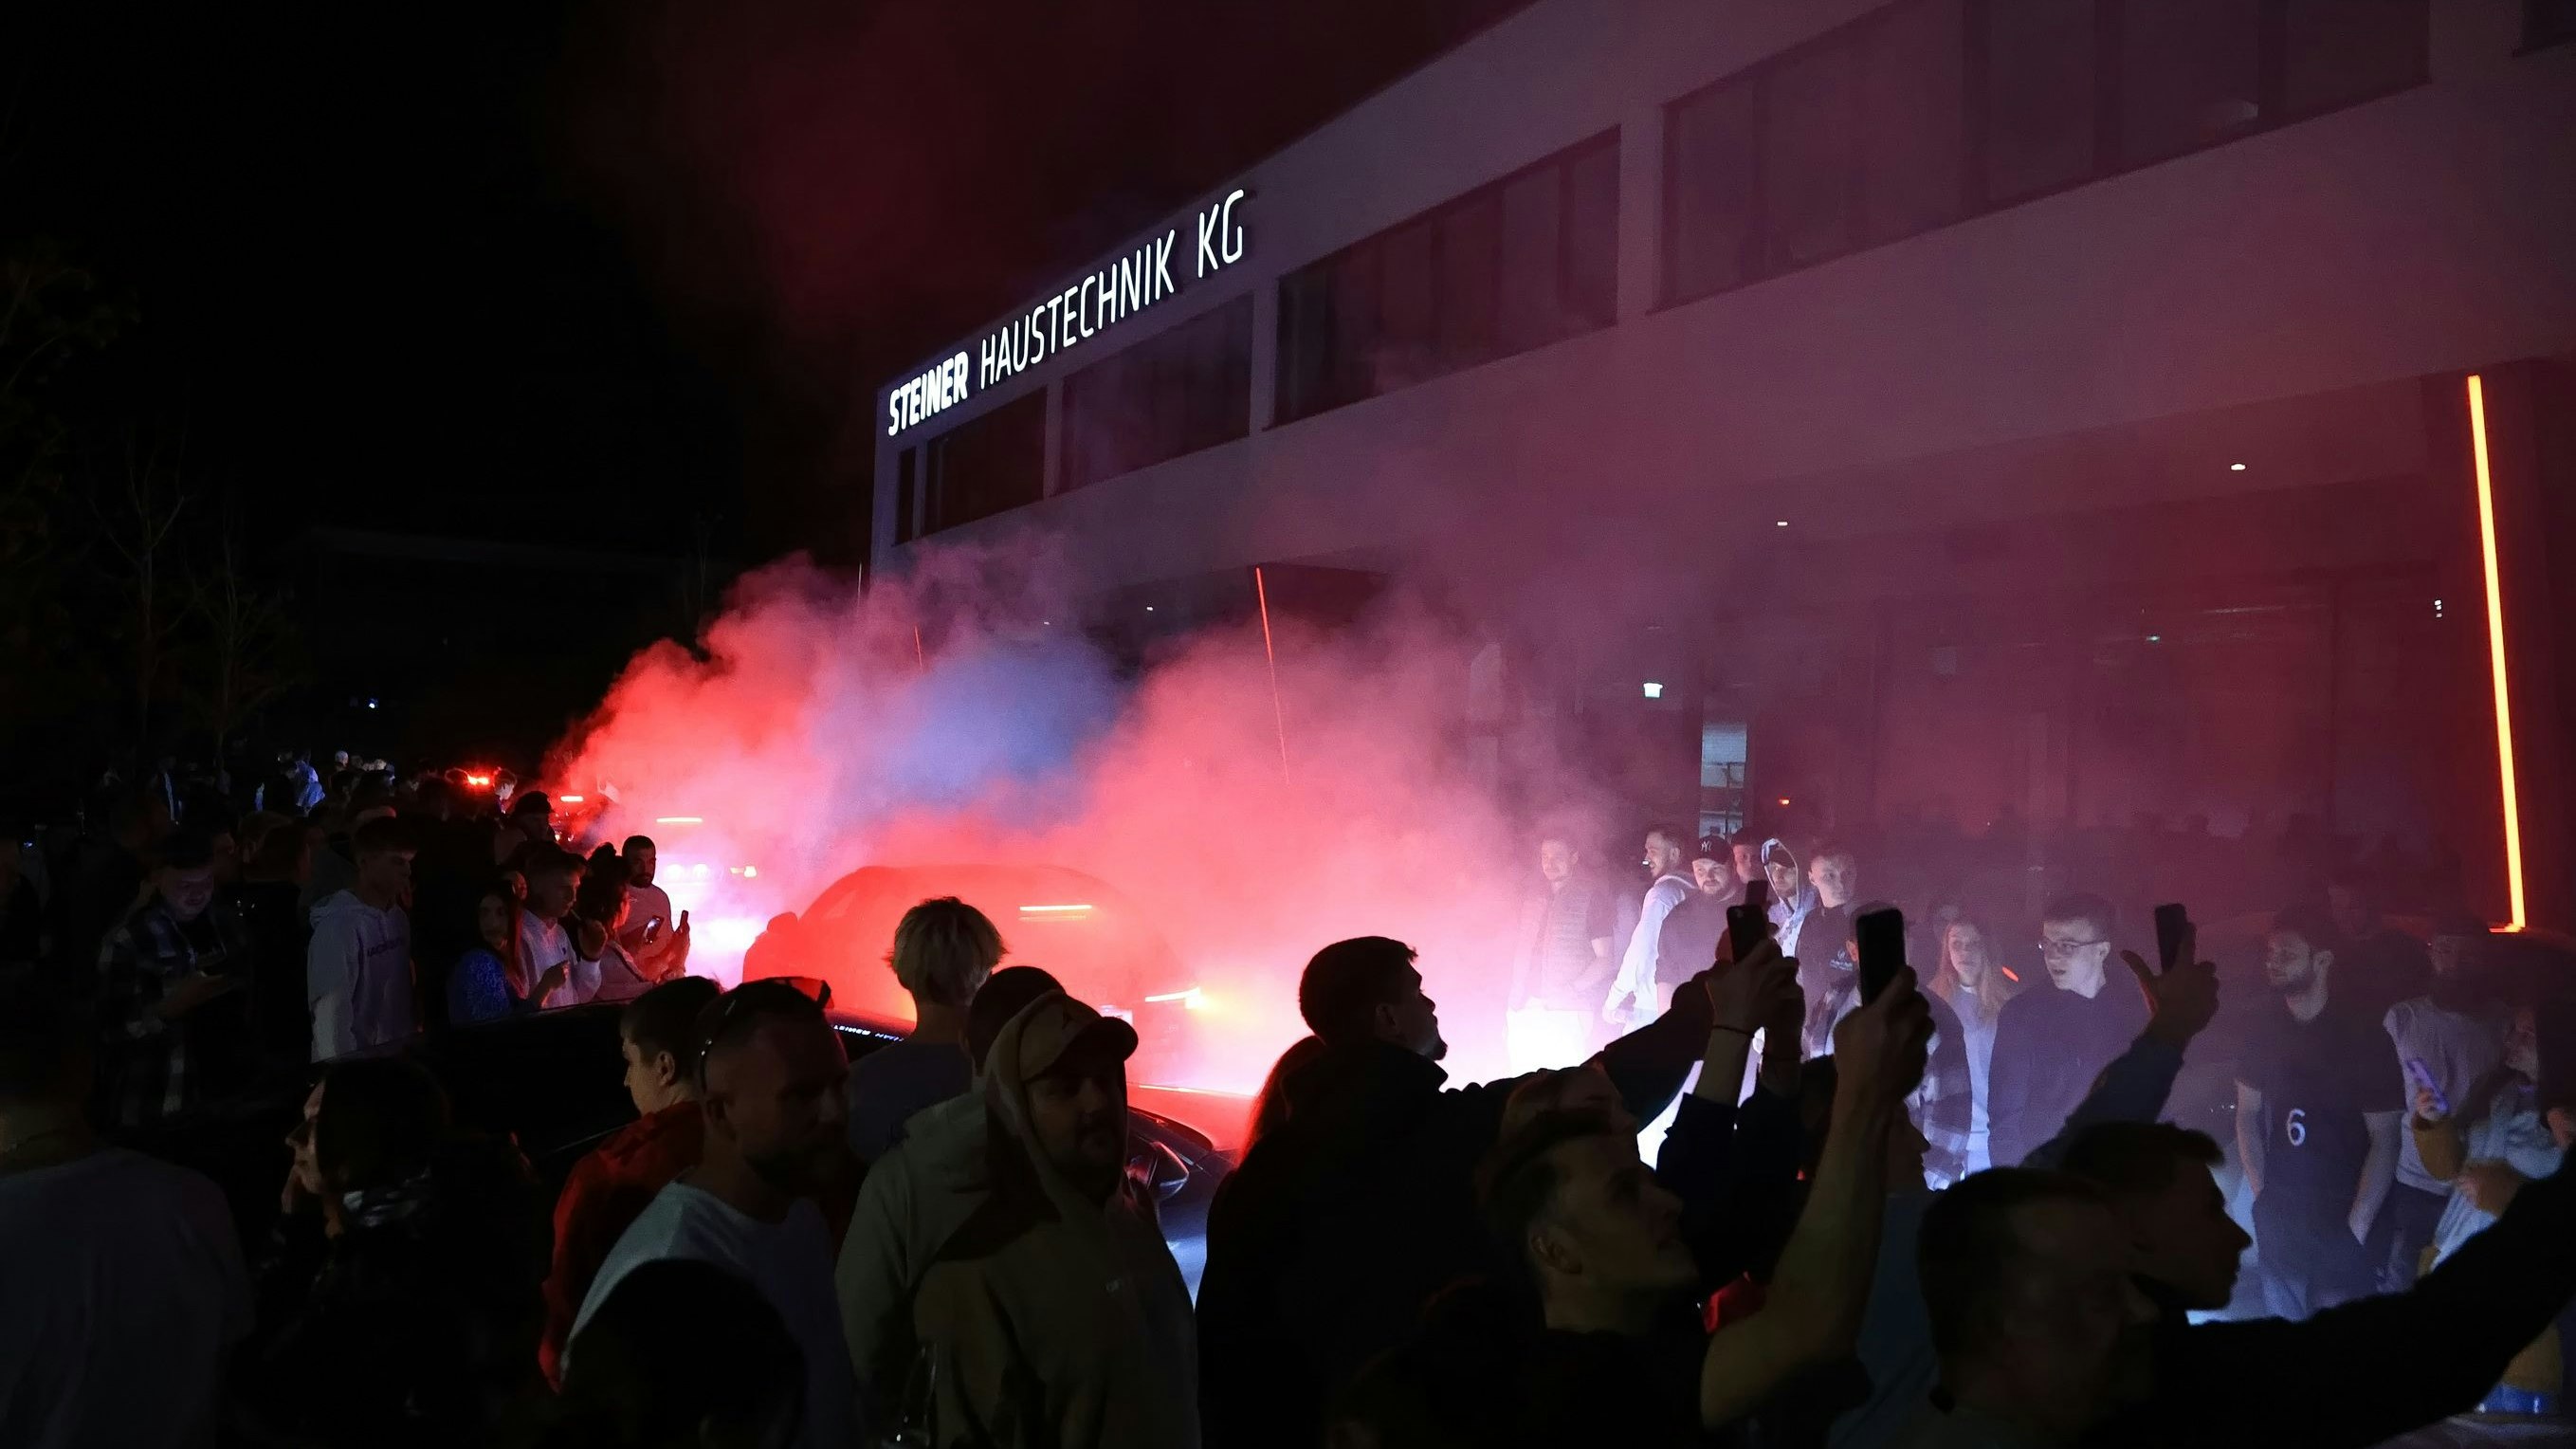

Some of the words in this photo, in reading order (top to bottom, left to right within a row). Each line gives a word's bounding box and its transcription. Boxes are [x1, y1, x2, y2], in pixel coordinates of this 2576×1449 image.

[887, 351, 969, 437] STEINER
[979, 229, 1176, 391] HAUSTECHNIK
[1197, 189, 1245, 279] KG
[2287, 1109, 2306, 1146] 6
